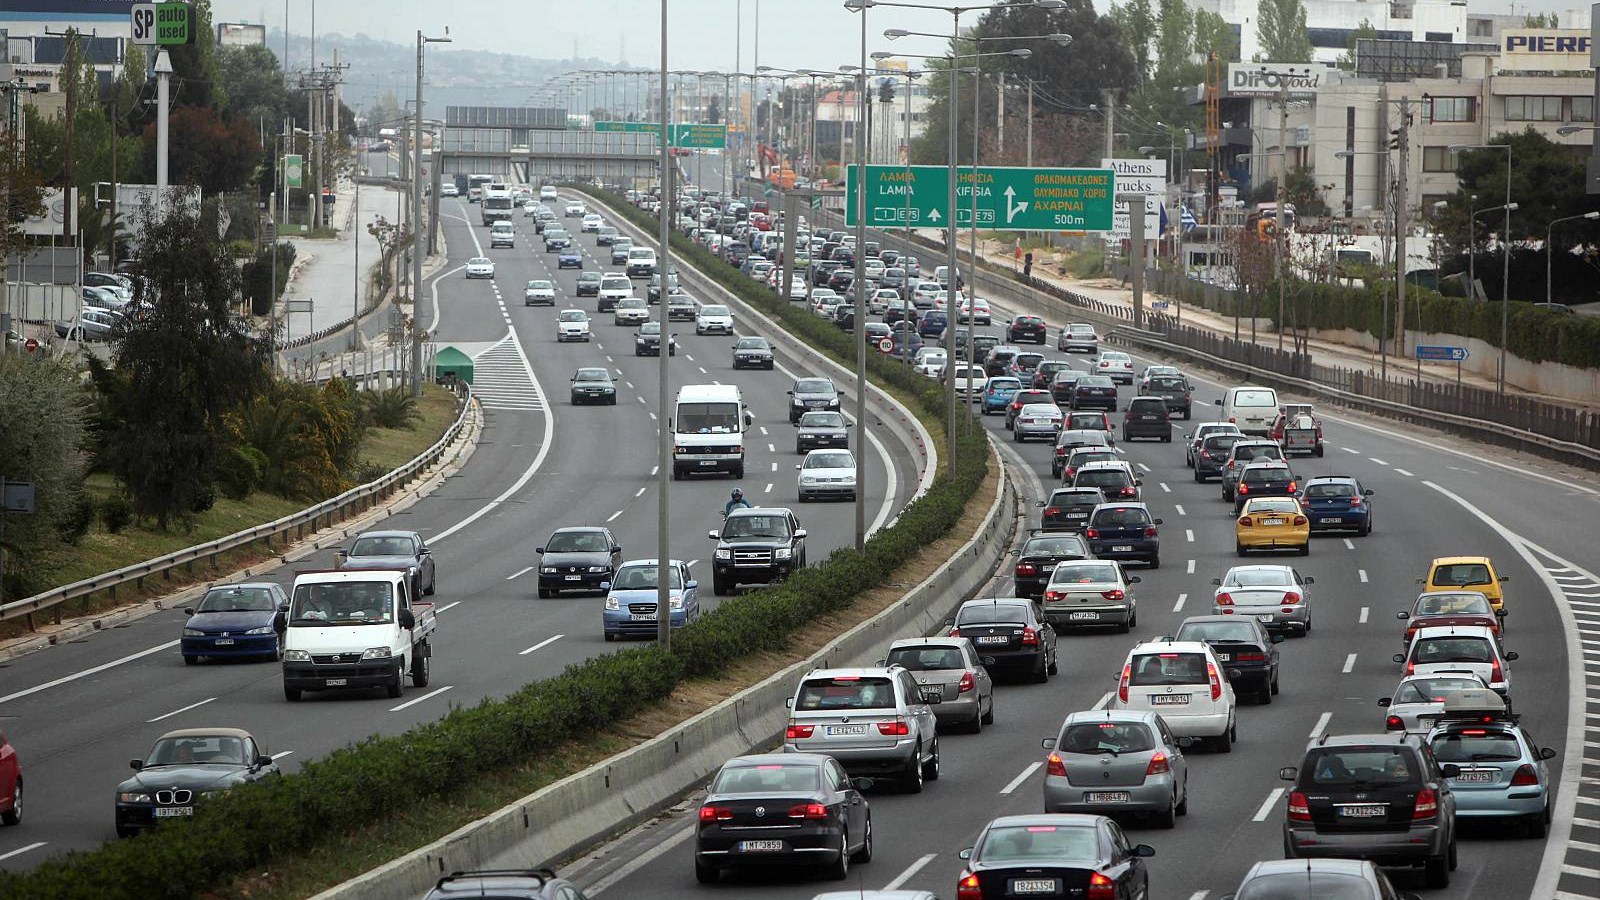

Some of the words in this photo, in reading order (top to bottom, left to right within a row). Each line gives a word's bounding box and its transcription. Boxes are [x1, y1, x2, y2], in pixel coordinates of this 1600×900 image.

[159, 8, 185, 22] auto
[134, 10, 154, 39] SP
[159, 24, 185, 38] used
[1111, 161, 1152, 174] Athens
[957, 173, 993, 183] ΗΦΣΙΑ
[880, 184, 914, 195] LAMIA
[1116, 179, 1152, 192] rucks
[1034, 201, 1083, 211] ΑΧΑΡΝΑΙ
